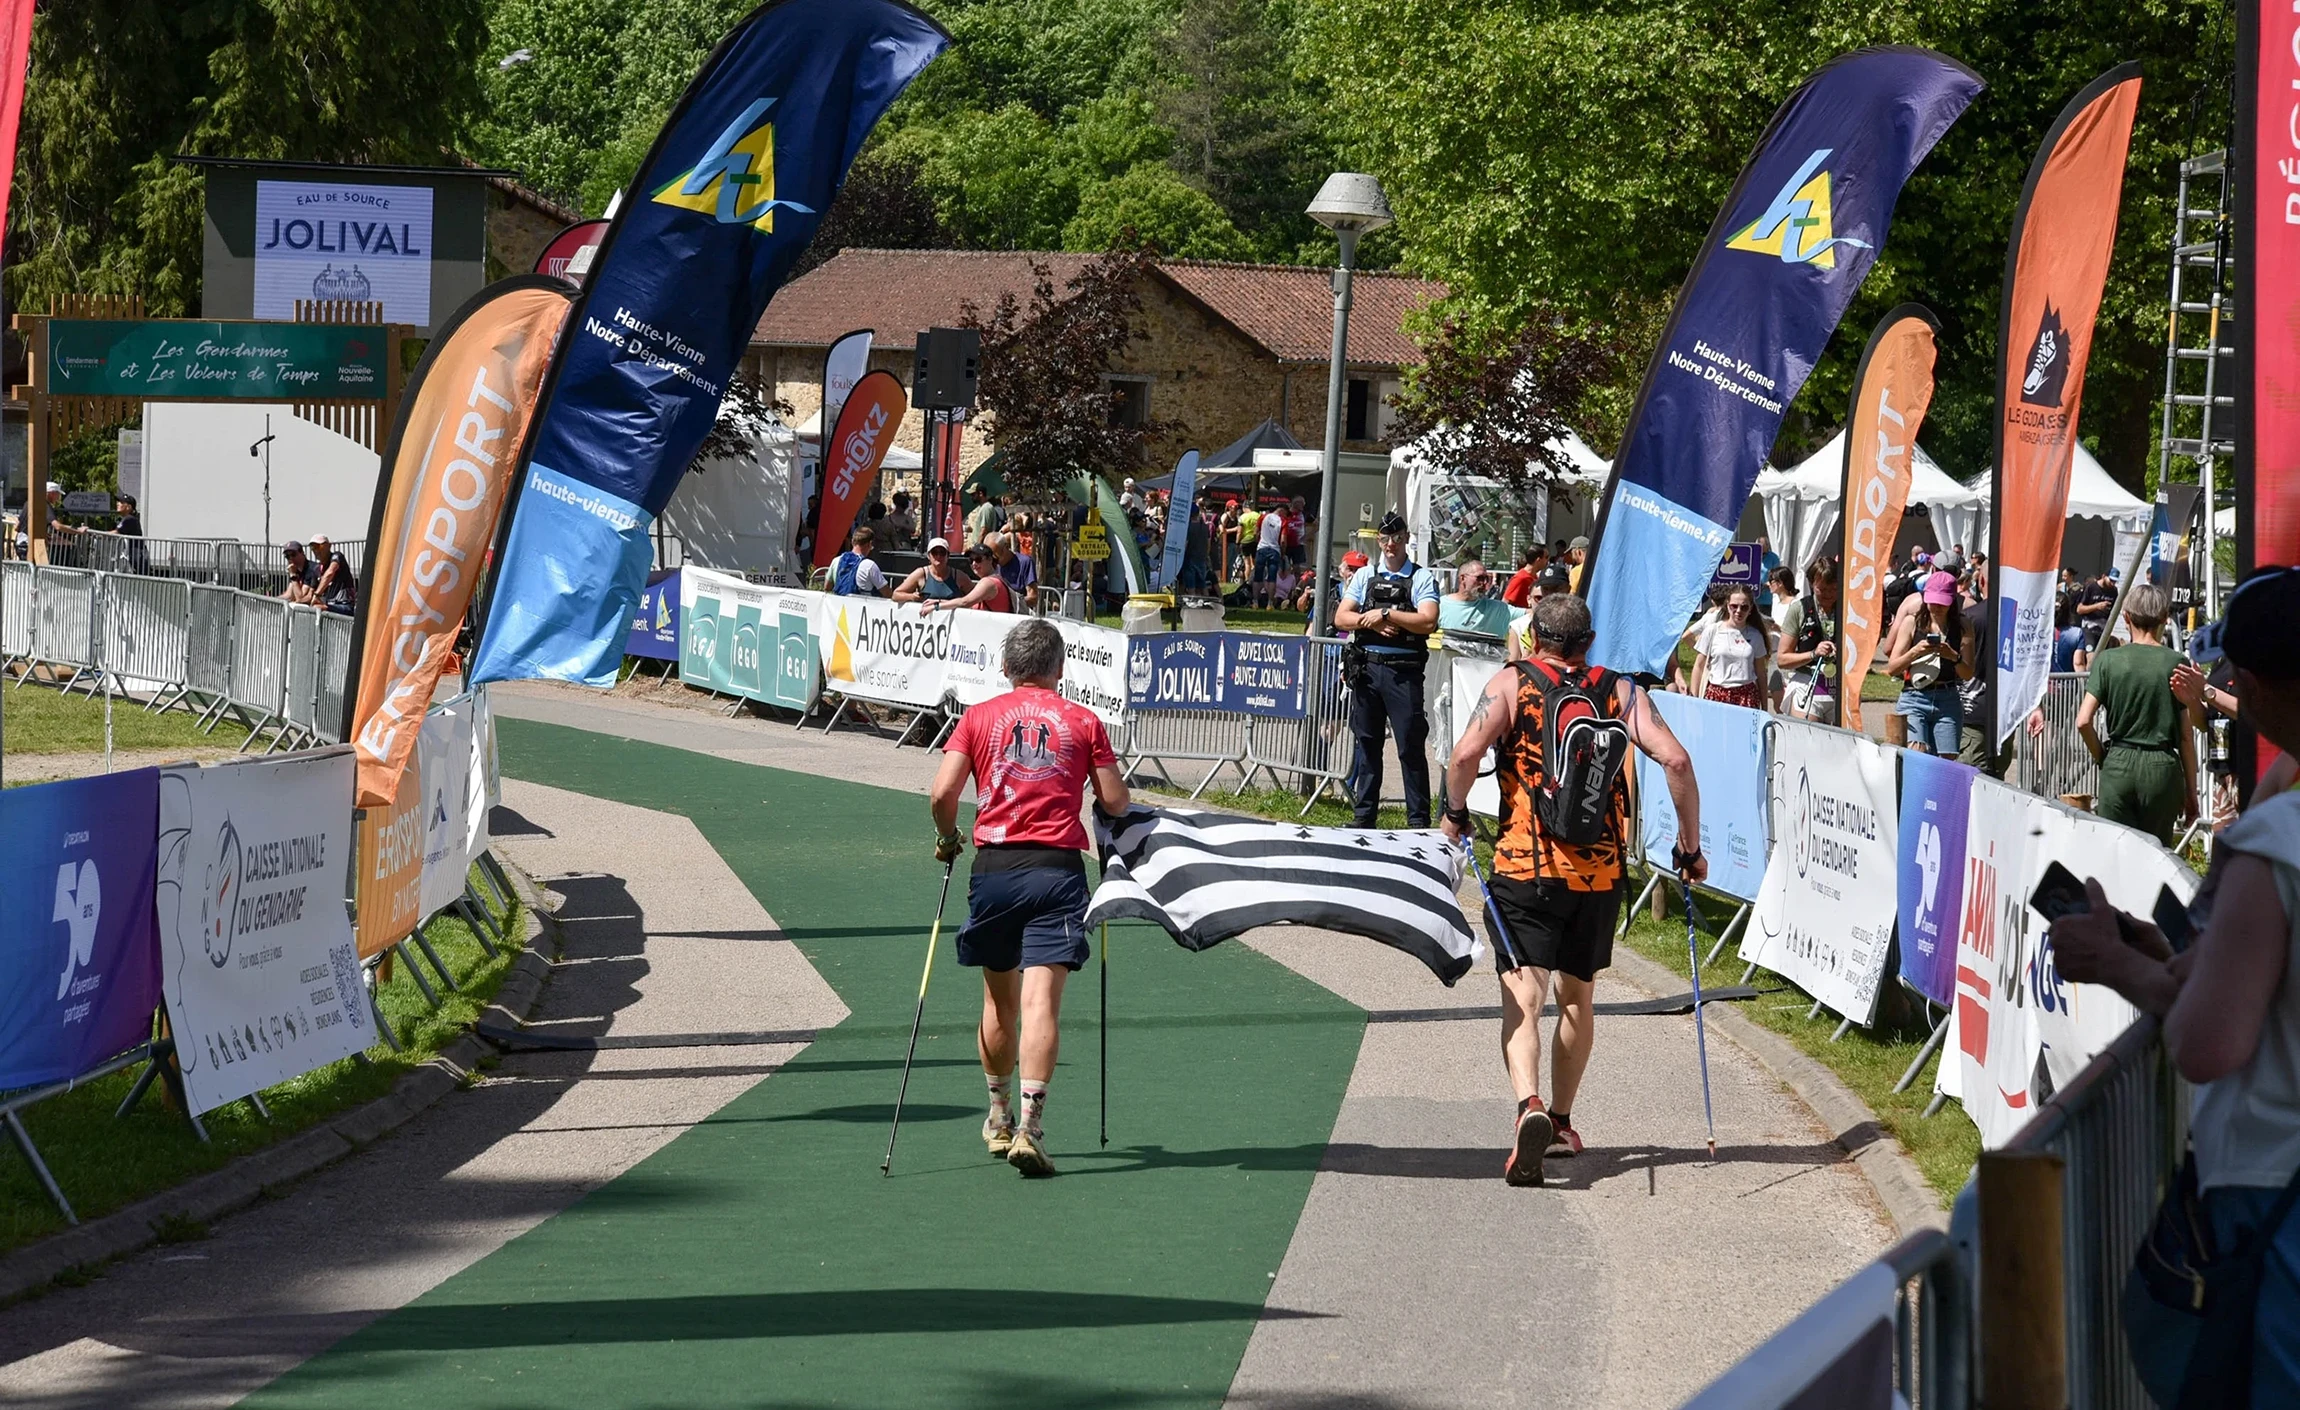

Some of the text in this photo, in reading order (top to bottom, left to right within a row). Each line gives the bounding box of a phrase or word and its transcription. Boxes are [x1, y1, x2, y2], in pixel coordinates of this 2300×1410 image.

[297, 192, 390, 209] EAU DE SOURCE
[263, 218, 421, 256] JOLIVAL
[152, 340, 289, 361] Les Gendarmes
[585, 316, 625, 347] Notre
[628, 338, 719, 396] Département
[614, 307, 706, 365] Haute-Vienne
[120, 362, 320, 386] et Les Voleurs de Temps
[338, 374, 374, 385] Aquitaine
[1668, 350, 1782, 415] Notre Département
[1693, 340, 1775, 390] Haute-Vienne
[832, 402, 889, 501] SHOKZ
[1619, 487, 1722, 548] haute-vienne.fr
[746, 574, 787, 584] CENTRE
[779, 599, 808, 613] association
[856, 606, 947, 661] Ambazac
[950, 643, 977, 665] Allianz
[1163, 639, 1206, 660] EAU DE SOURCE
[1237, 641, 1262, 661] BUVEZ
[1065, 679, 1080, 702] Ville
[1080, 684, 1091, 705] de
[1154, 667, 1211, 703] JOLIVAL
[1234, 665, 1257, 687] BUVEZ
[1812, 792, 1834, 827] CAISSE
[1835, 799, 1876, 841] NATIONALE
[246, 833, 326, 883] CAISSE NATIONALE
[1811, 833, 1858, 879] DU GENDARME
[1915, 821, 1941, 929] 50
[52, 858, 101, 1001] 50
[239, 886, 307, 936] DU GENDARME
